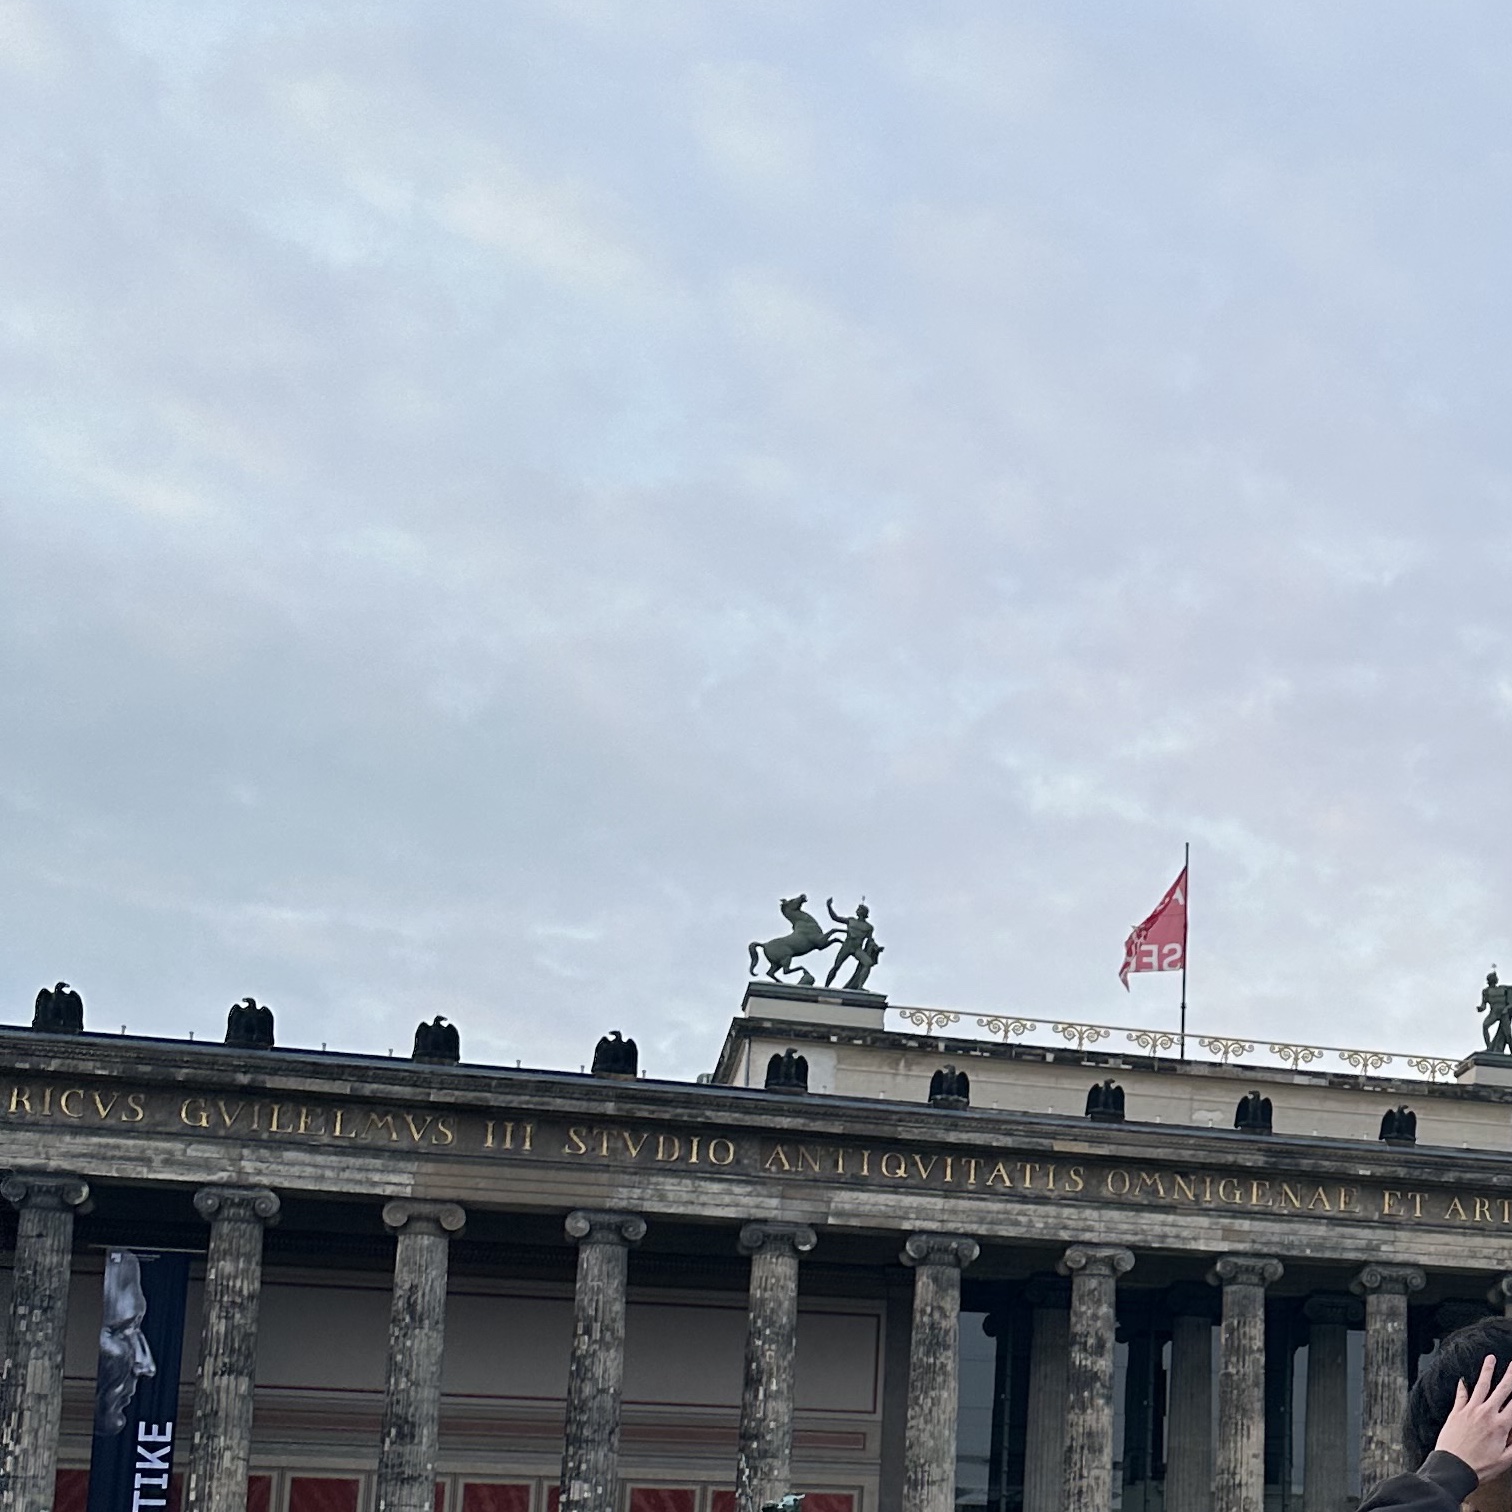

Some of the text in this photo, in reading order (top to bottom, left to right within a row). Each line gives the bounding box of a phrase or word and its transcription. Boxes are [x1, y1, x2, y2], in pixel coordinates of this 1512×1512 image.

[8, 1086, 145, 1122] RICVS
[180, 1099, 454, 1145] GVILELMVS
[484, 1121, 533, 1150] III
[564, 1127, 735, 1165] STVDIO
[764, 1144, 1084, 1192] ANTIQVITATIS
[1107, 1169, 1360, 1213] OMNIGENAE
[1382, 1190, 1428, 1217] ET
